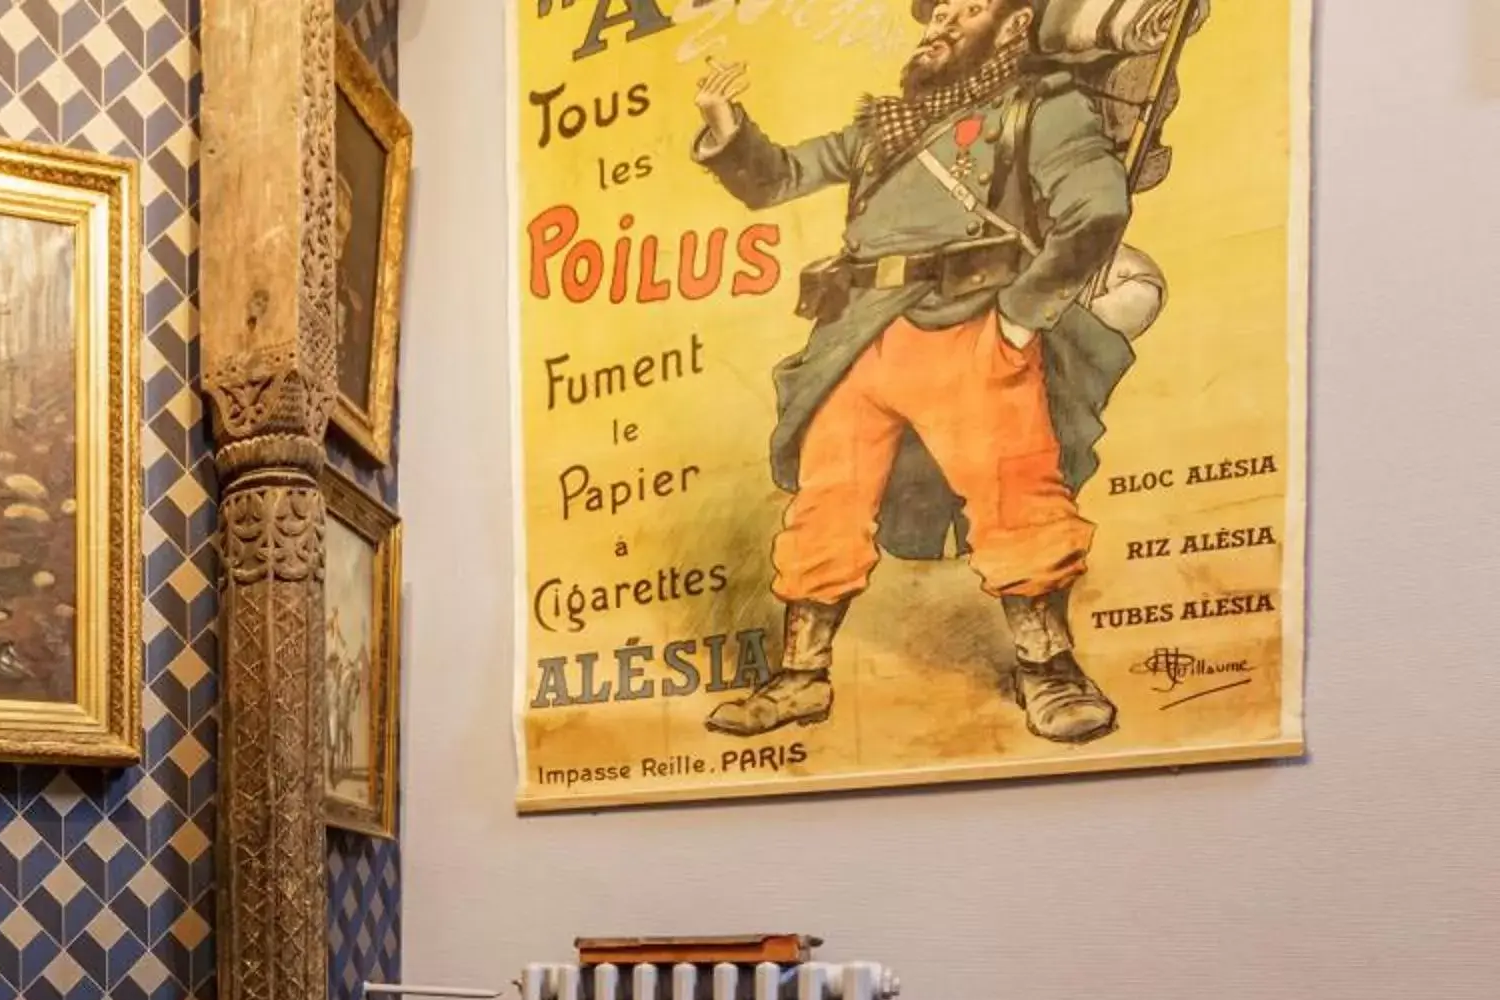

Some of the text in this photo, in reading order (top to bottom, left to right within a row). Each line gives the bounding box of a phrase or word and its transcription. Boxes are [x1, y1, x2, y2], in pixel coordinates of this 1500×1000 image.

[529, 83, 651, 149] Tous
[598, 154, 654, 190] les
[545, 333, 704, 410] Fument
[612, 419, 639, 444] le
[559, 464, 700, 520] Papier
[1108, 455, 1278, 496] BLOC ALÉSIA
[1126, 526, 1276, 560] RIZ ALÉSIA
[534, 563, 728, 633] Cigarettes
[1092, 604, 1173, 629] TUBES
[530, 627, 774, 708] ALÉSIA
[538, 757, 632, 788] Impasse
[720, 742, 808, 773] PARIS
